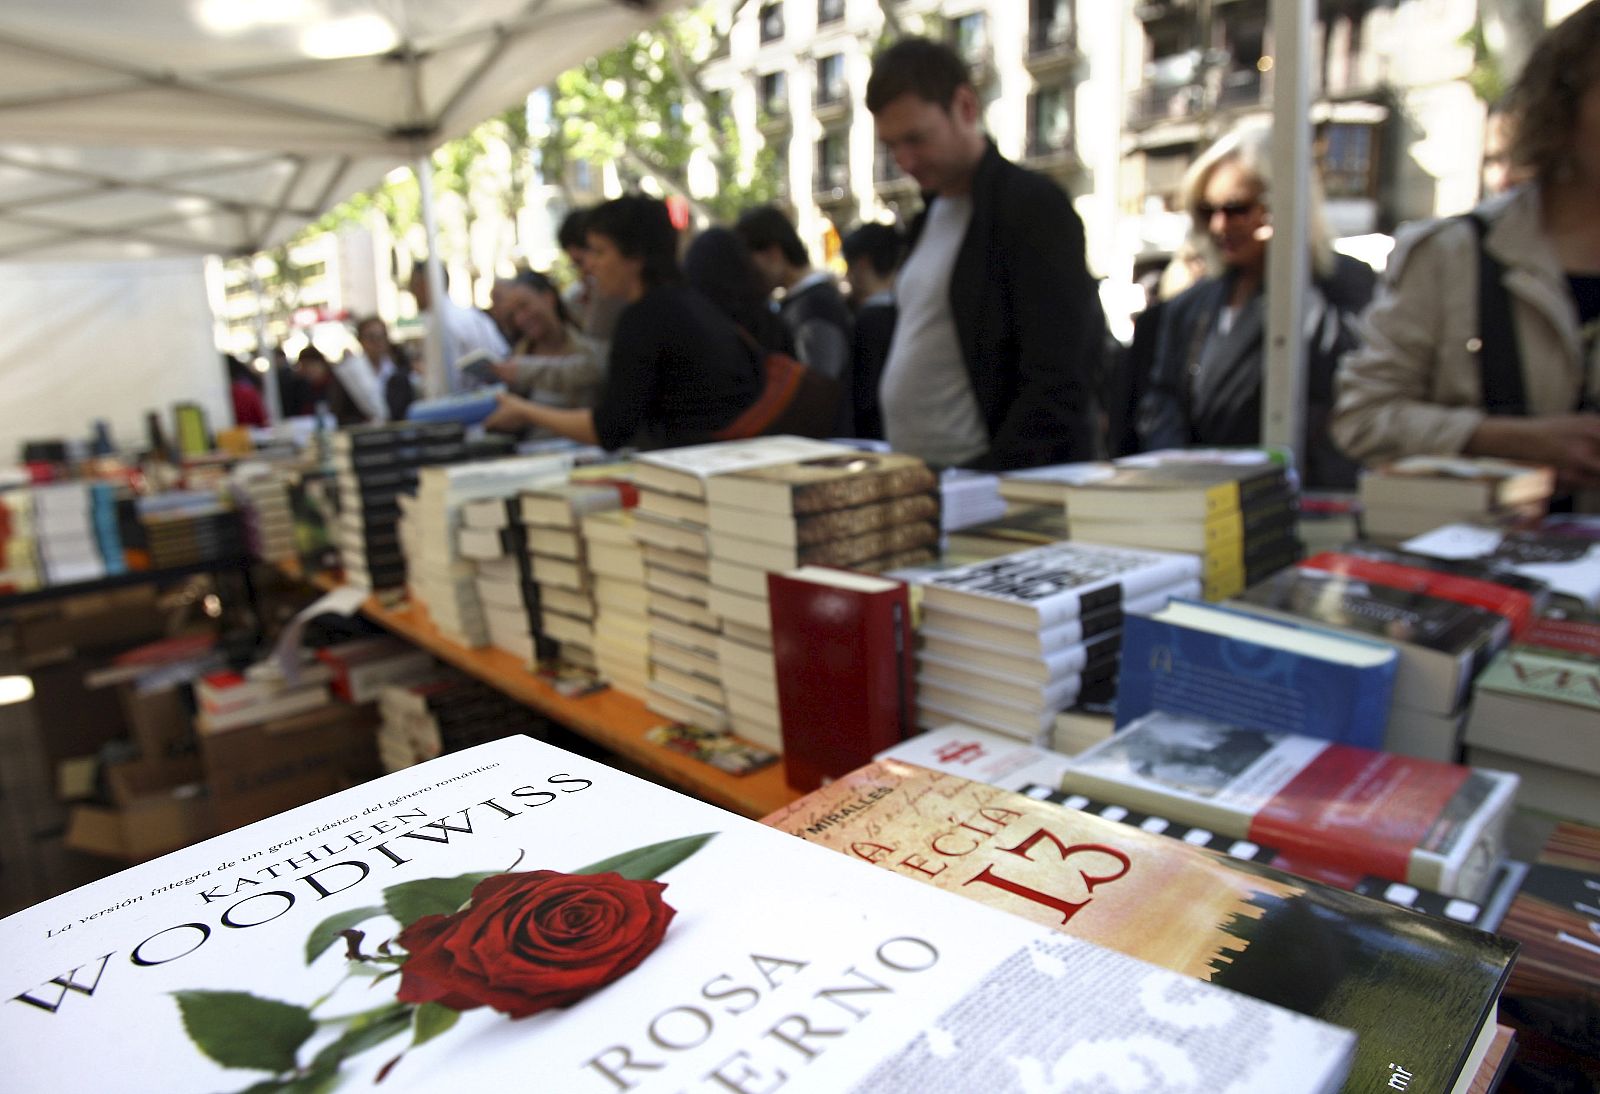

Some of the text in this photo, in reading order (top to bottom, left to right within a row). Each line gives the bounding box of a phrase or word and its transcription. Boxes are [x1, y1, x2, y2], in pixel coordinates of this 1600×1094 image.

[46, 761, 501, 939] La versión íntegra de un gran clásico del género romántico
[196, 807, 428, 905] KATHLEEN
[805, 786, 894, 836] MIRALLES
[850, 840, 896, 865] A
[896, 807, 1024, 880] ECÍA
[6, 773, 593, 1013] WOODIWISS
[961, 827, 1132, 926] 13
[580, 954, 811, 1093] ROSA
[694, 936, 940, 1094] ERNO
